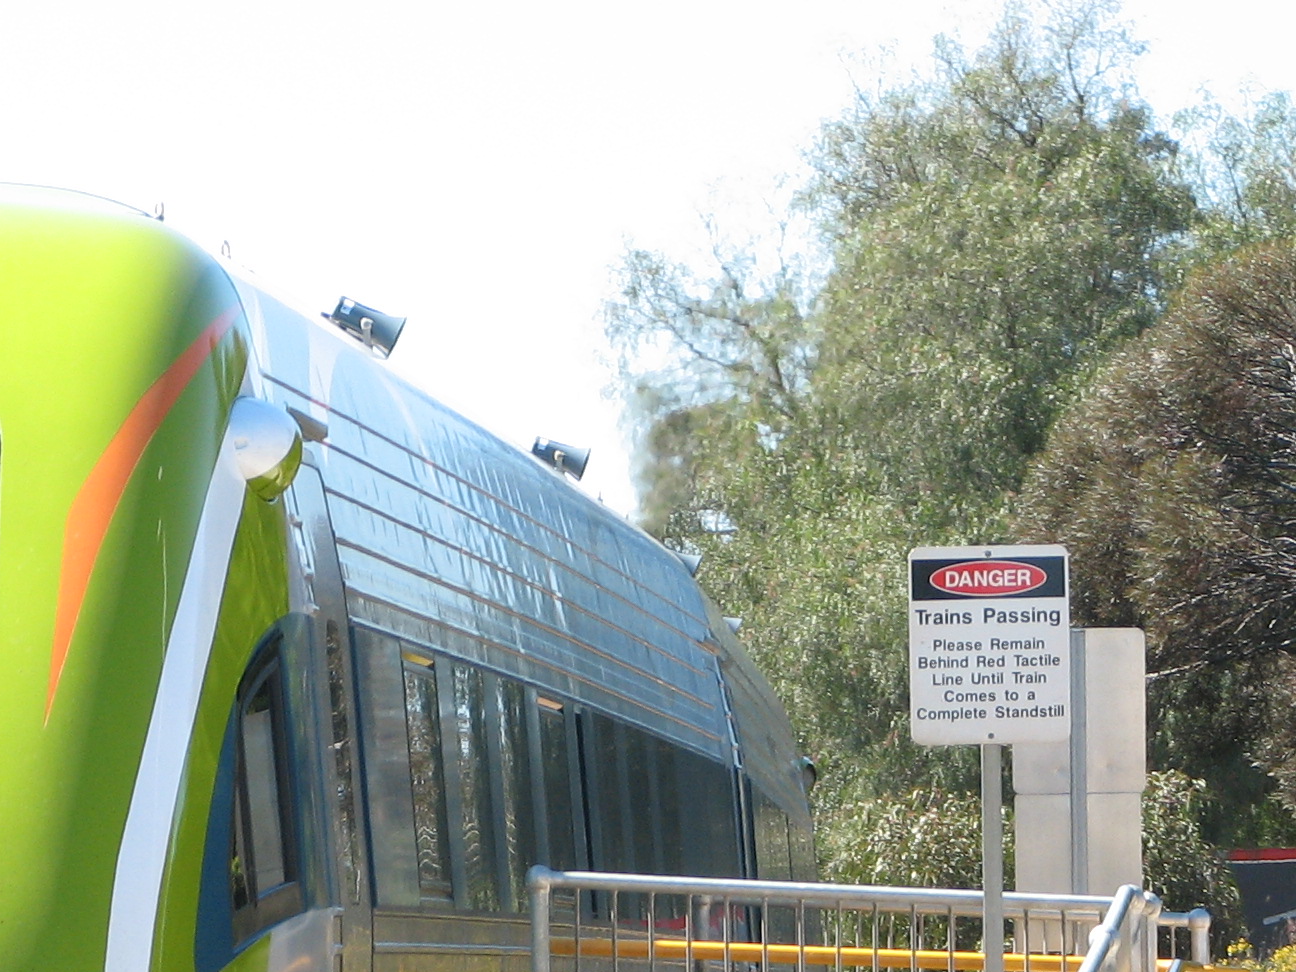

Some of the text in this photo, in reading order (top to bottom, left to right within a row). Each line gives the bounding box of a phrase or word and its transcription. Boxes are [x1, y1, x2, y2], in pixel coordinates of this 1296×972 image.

[945, 569, 1032, 588] DANGER
[915, 607, 1061, 626] Trains Passing
[933, 637, 1045, 651] Please Remain
[918, 654, 1060, 669] Behind Red Tactile
[932, 671, 1047, 686] Line Until Train
[943, 689, 1035, 702] Comes to a
[916, 705, 1064, 722] Complete Standstill
